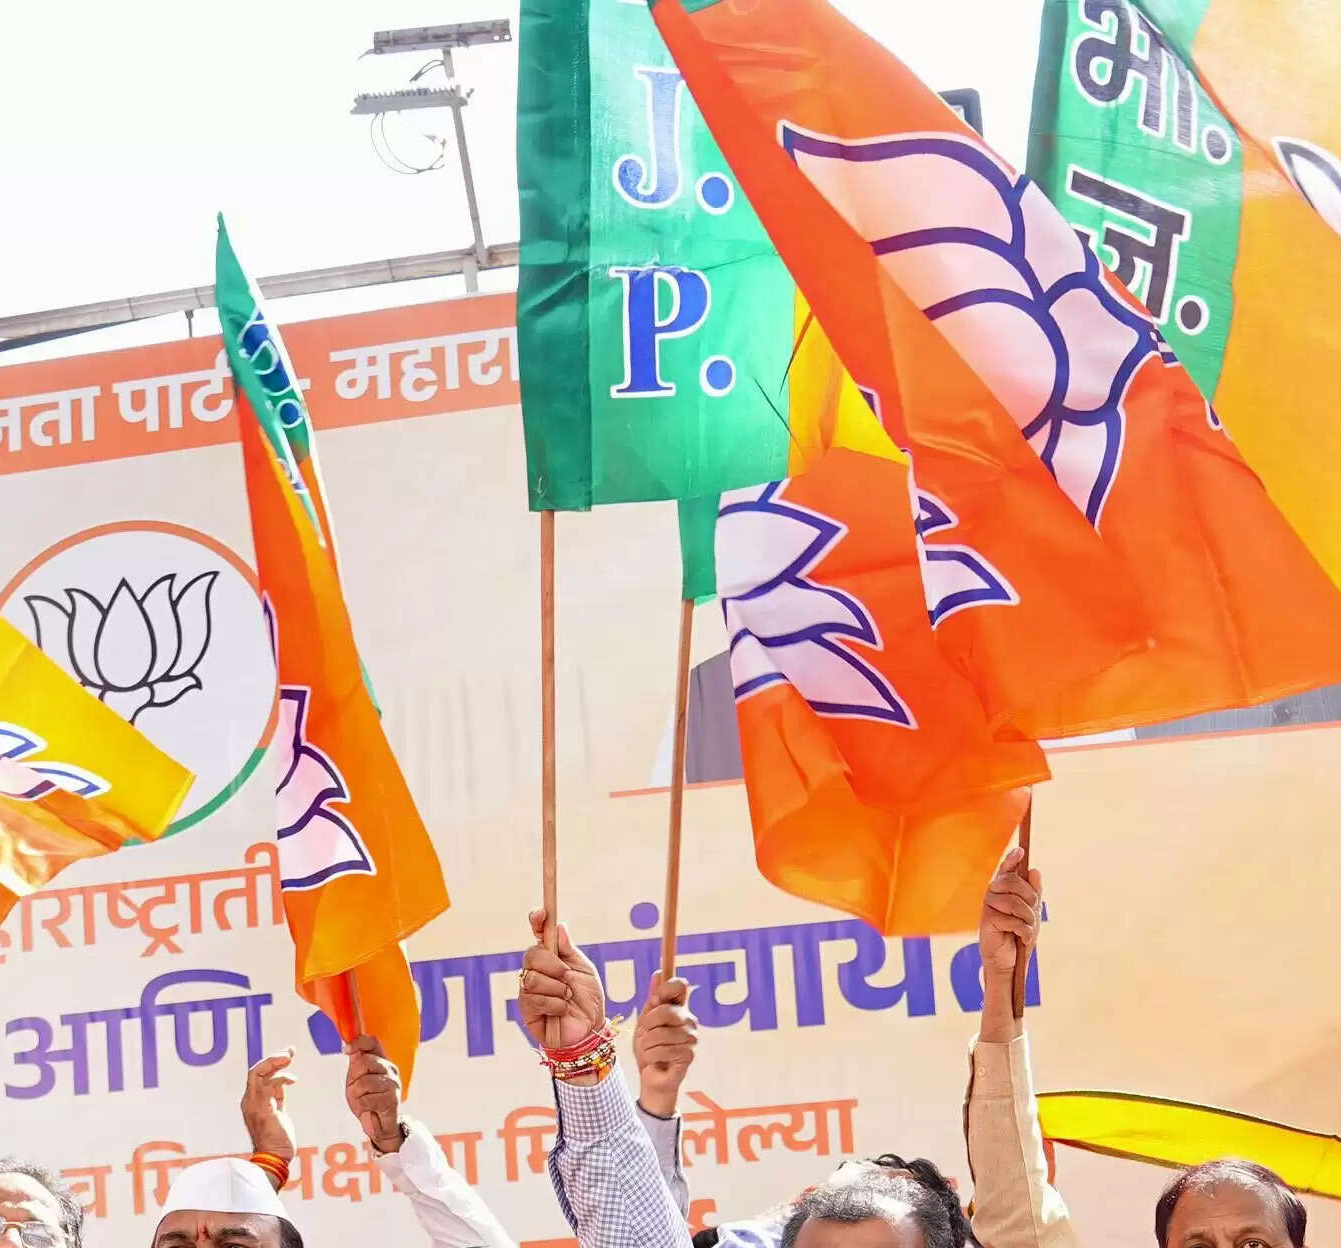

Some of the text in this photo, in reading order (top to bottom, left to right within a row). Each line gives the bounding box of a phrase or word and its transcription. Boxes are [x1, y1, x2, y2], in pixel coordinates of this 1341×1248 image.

[612, 65, 733, 214] J.
[113, 348, 234, 434] पाट
[610, 265, 737, 399] P.
[3, 968, 274, 1100] आणि
